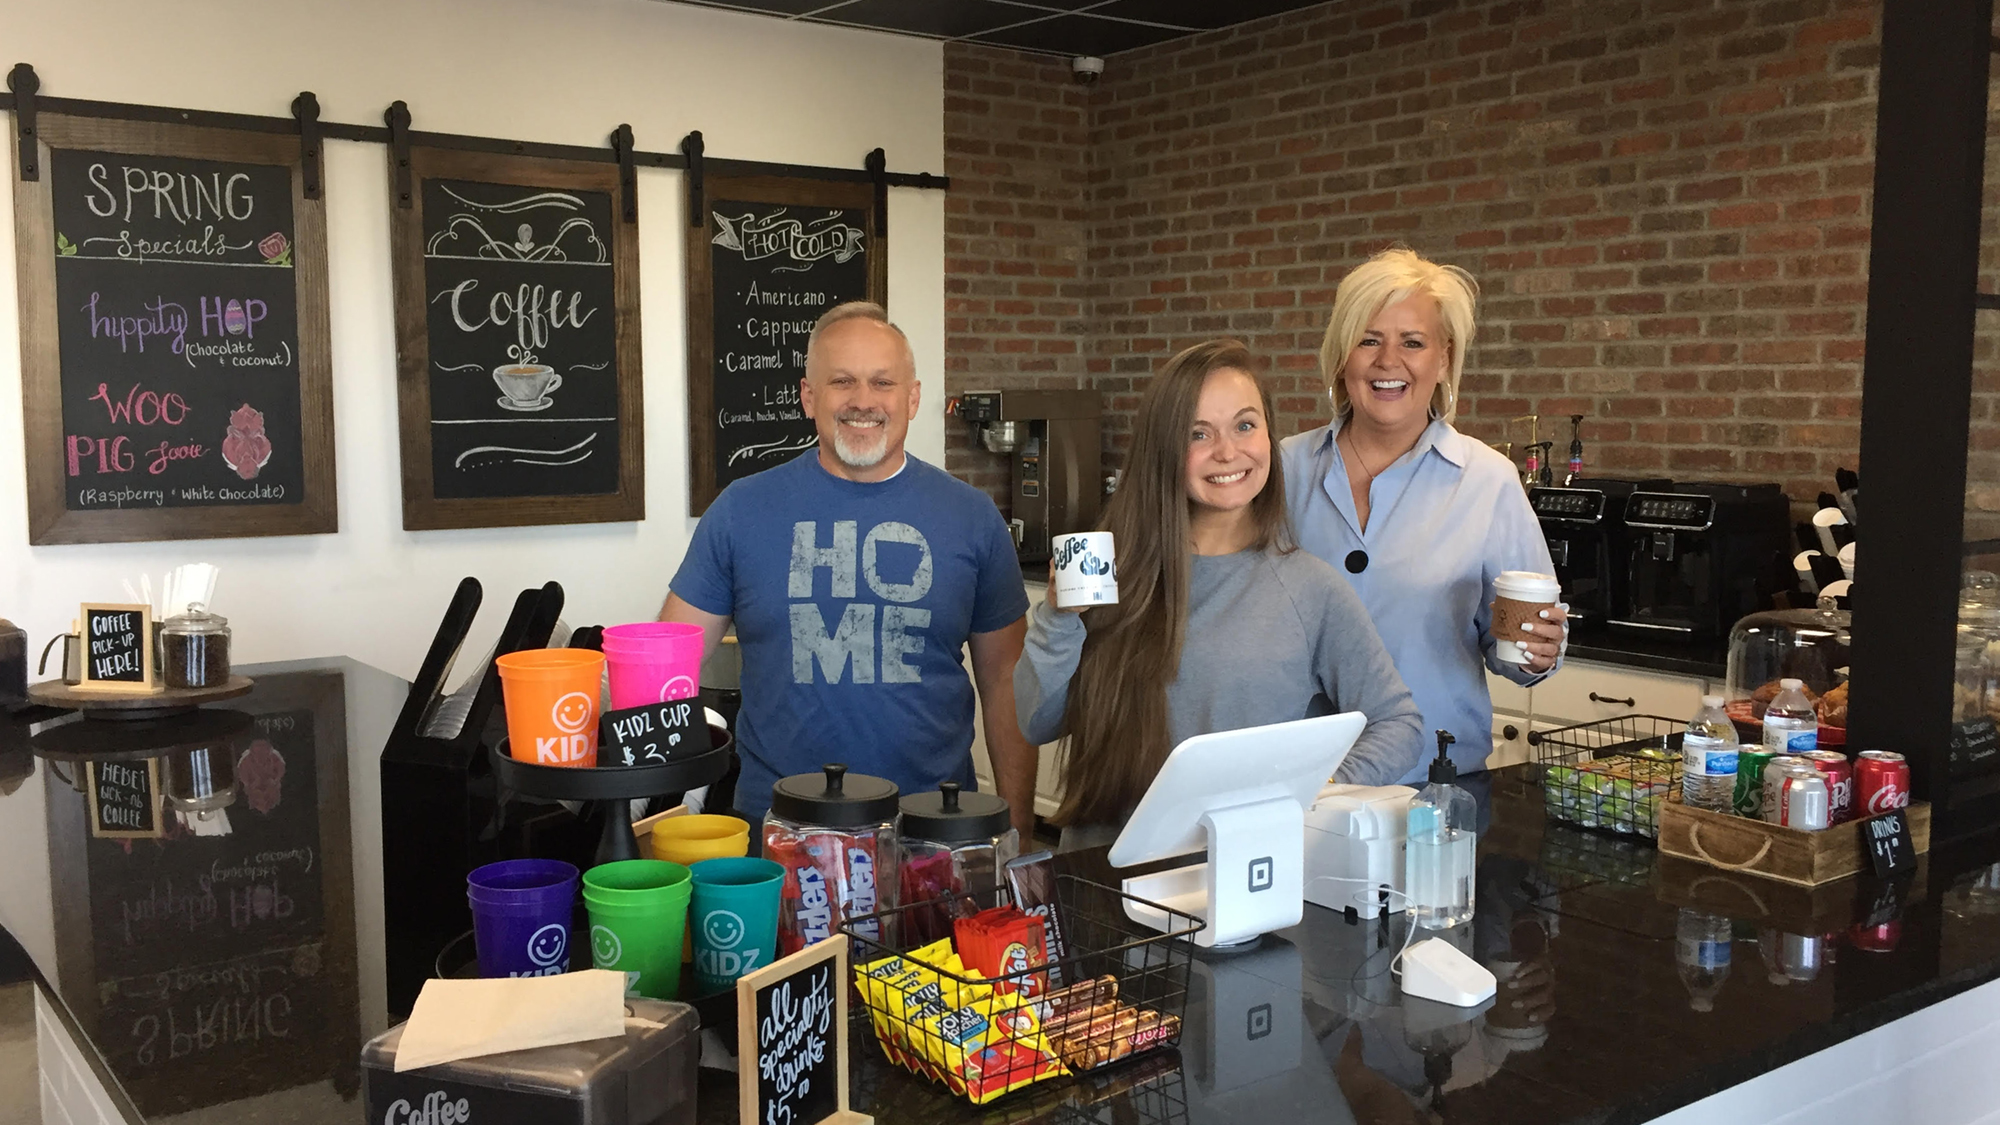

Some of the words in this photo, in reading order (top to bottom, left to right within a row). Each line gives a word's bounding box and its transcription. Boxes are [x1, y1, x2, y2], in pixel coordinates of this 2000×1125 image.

[84, 163, 254, 225] SPRING
[83, 225, 253, 264] Specials
[748, 227, 790, 256] HOT
[797, 231, 844, 257] COLD
[745, 280, 826, 307] Americano
[81, 291, 188, 354] hippity
[431, 279, 598, 350] Coffee
[726, 350, 783, 372] Caramel
[67, 435, 135, 477] PIG
[79, 484, 164, 508] (Raspberry
[182, 485, 215, 500] White
[218, 484, 285, 501] Chocolate)
[788, 520, 933, 603] HO
[1053, 536, 1089, 571] Coffee
[92, 613, 132, 637] COFFEE
[92, 632, 135, 655] PICK-UP
[789, 603, 932, 684] ME
[96, 648, 140, 680] HERE!
[613, 712, 654, 743] KIDZ
[660, 703, 692, 729] CUP
[1871, 816, 1900, 838] DRINKS
[1050, 903, 1062, 939] chocolate
[696, 949, 760, 977] KIDZ
[1057, 941, 1065, 957] milk
[761, 981, 799, 1048] all
[775, 1031, 827, 1094] drinks
